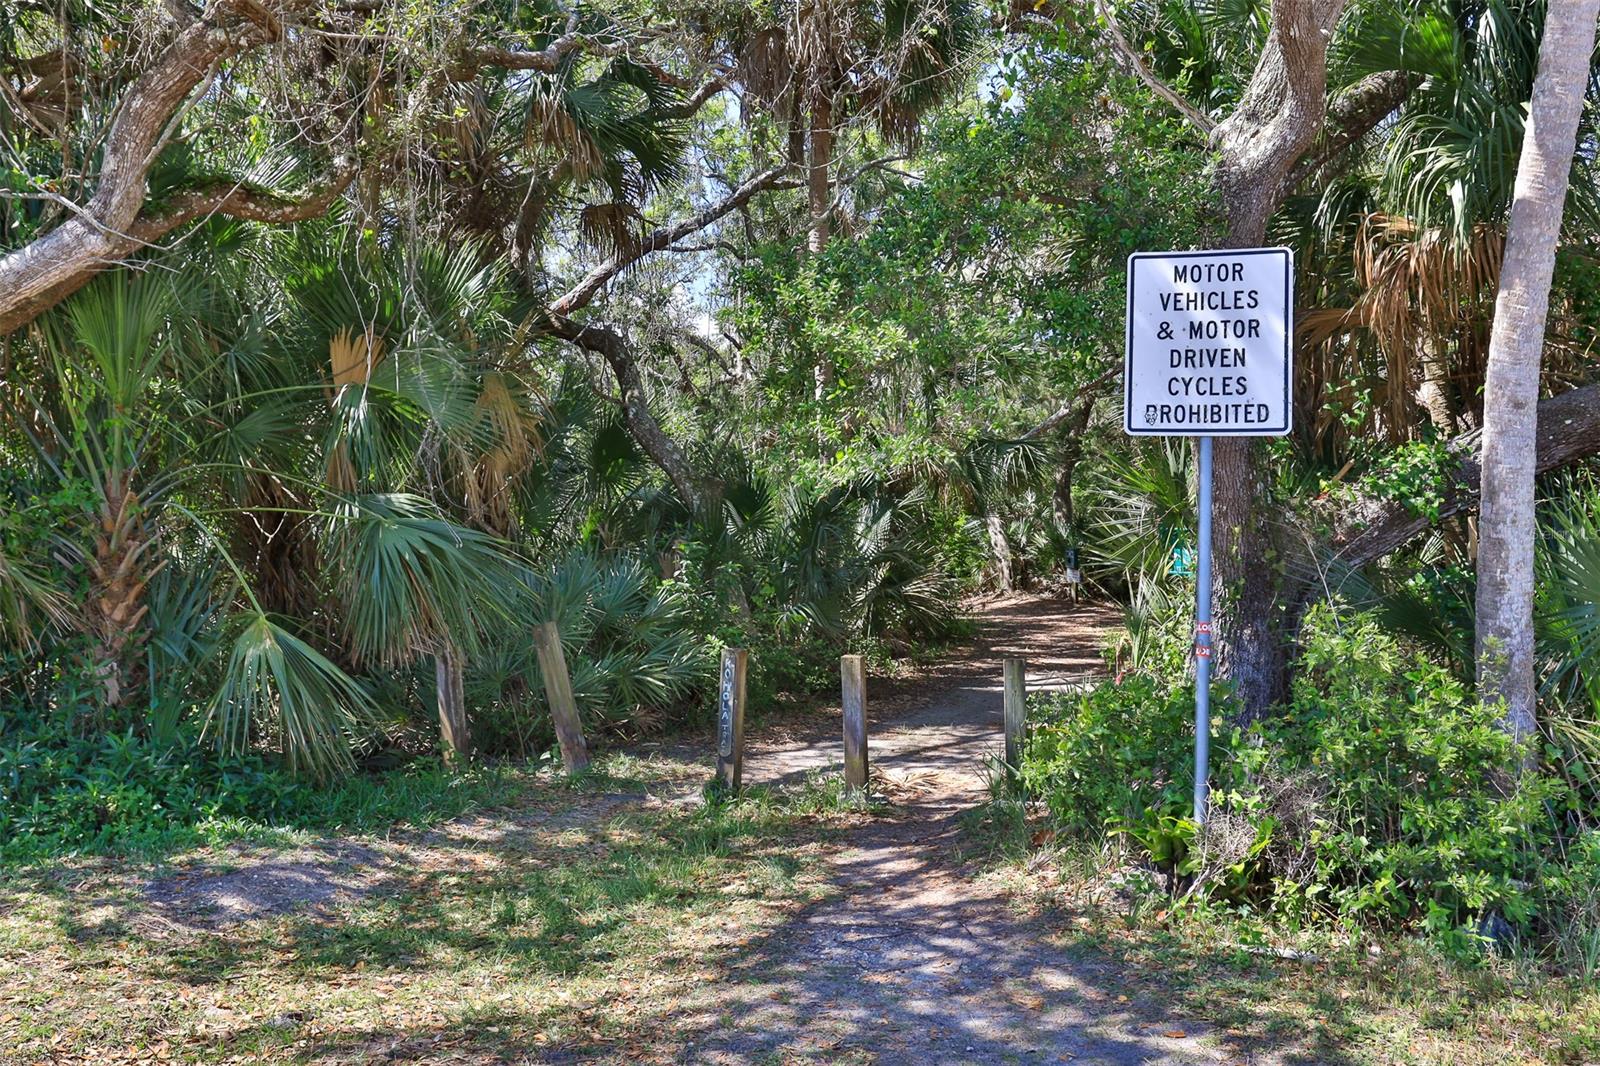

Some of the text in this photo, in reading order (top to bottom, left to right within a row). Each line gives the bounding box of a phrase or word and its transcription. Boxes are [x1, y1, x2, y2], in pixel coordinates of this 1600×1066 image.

[1173, 262, 1244, 284] MOTOR
[1159, 289, 1259, 312] VEHICLES
[1156, 318, 1261, 341] & MOTOR
[1169, 347, 1246, 369] DRIVEN
[1167, 375, 1248, 397] CYCLES
